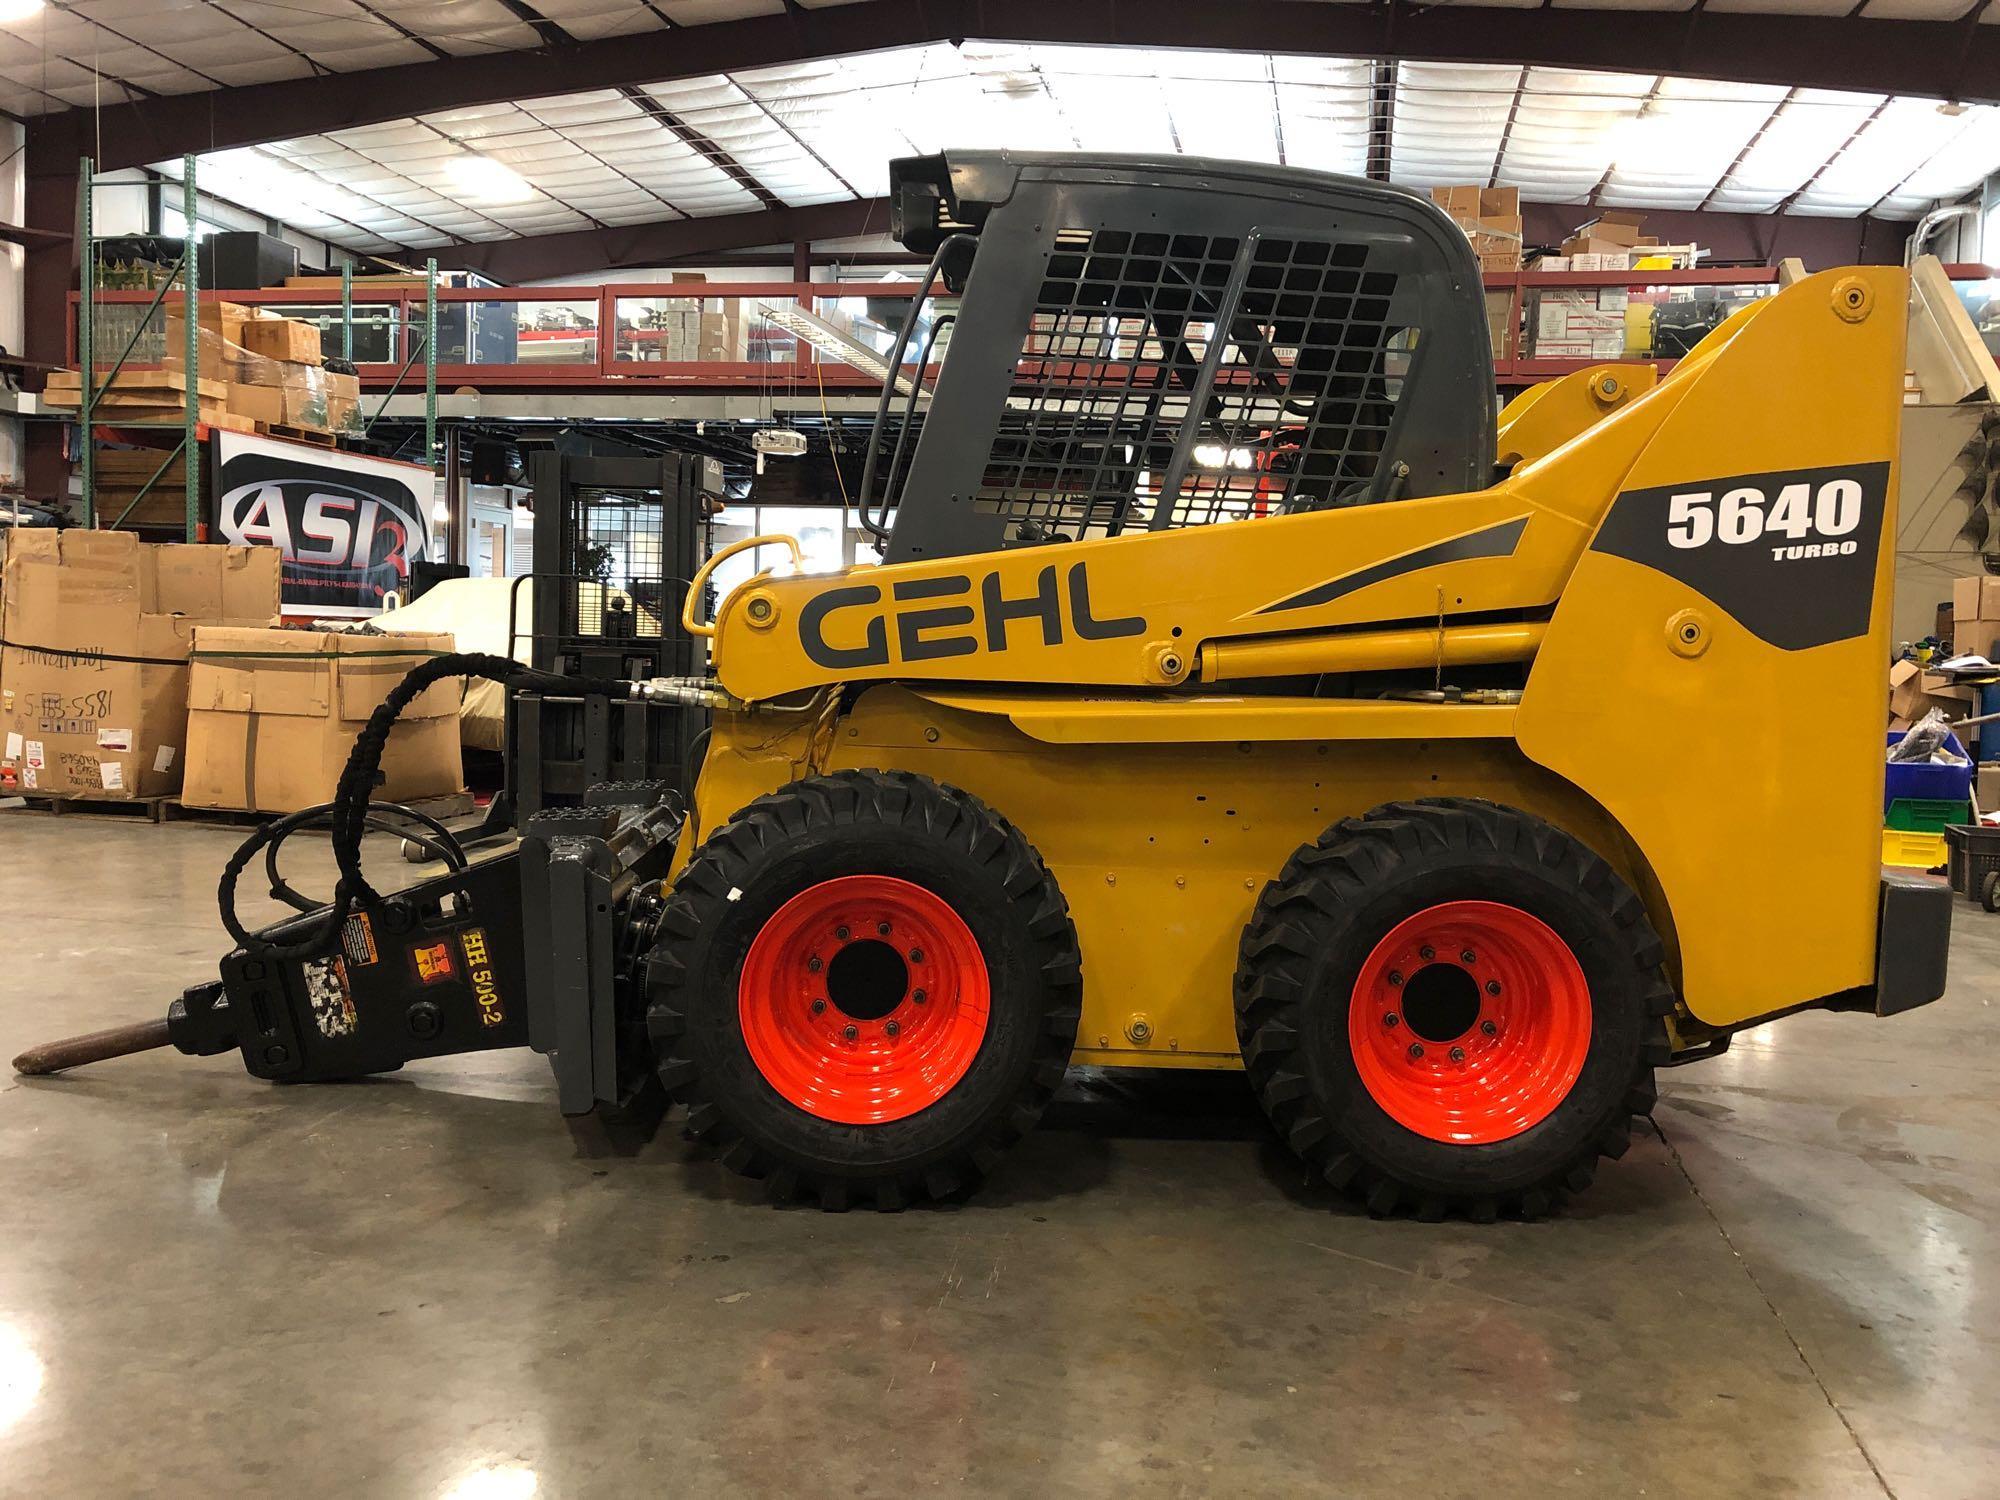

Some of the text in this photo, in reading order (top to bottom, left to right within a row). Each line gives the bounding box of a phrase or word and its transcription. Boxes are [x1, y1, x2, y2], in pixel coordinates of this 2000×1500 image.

[1667, 479, 1863, 549] 5640
[1771, 540, 1858, 562] TURBO
[798, 561, 1147, 669] GEHL
[462, 931, 503, 1025] HH 500-2
